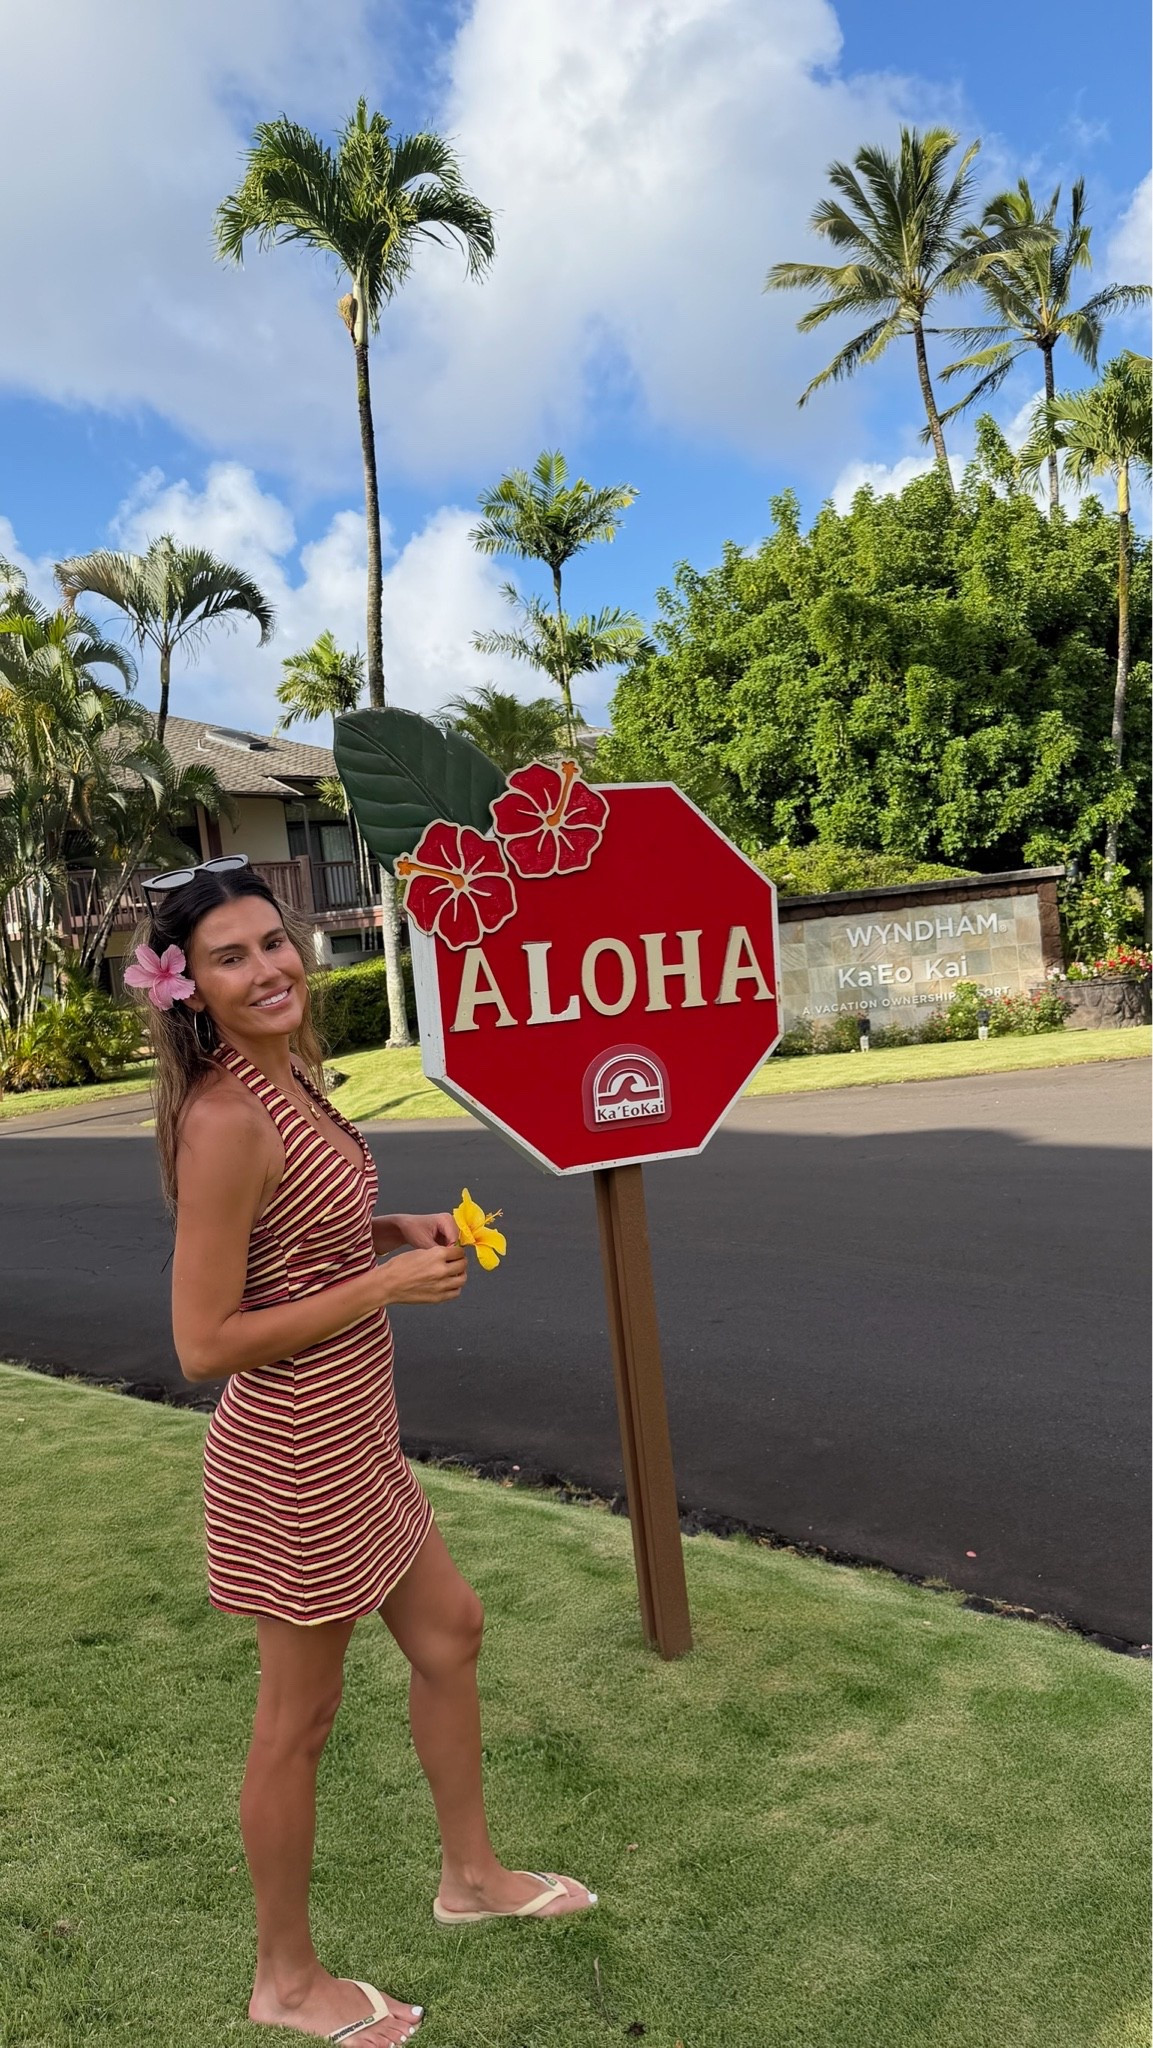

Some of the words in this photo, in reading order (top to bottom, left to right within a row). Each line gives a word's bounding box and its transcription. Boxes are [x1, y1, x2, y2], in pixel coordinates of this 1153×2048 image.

[449, 926, 776, 1033] ALOHA
[925, 955, 969, 980] Kai
[802, 1006, 811, 1016] A
[815, 999, 878, 1014] VACATION
[882, 991, 956, 1007] OWNERSHIP
